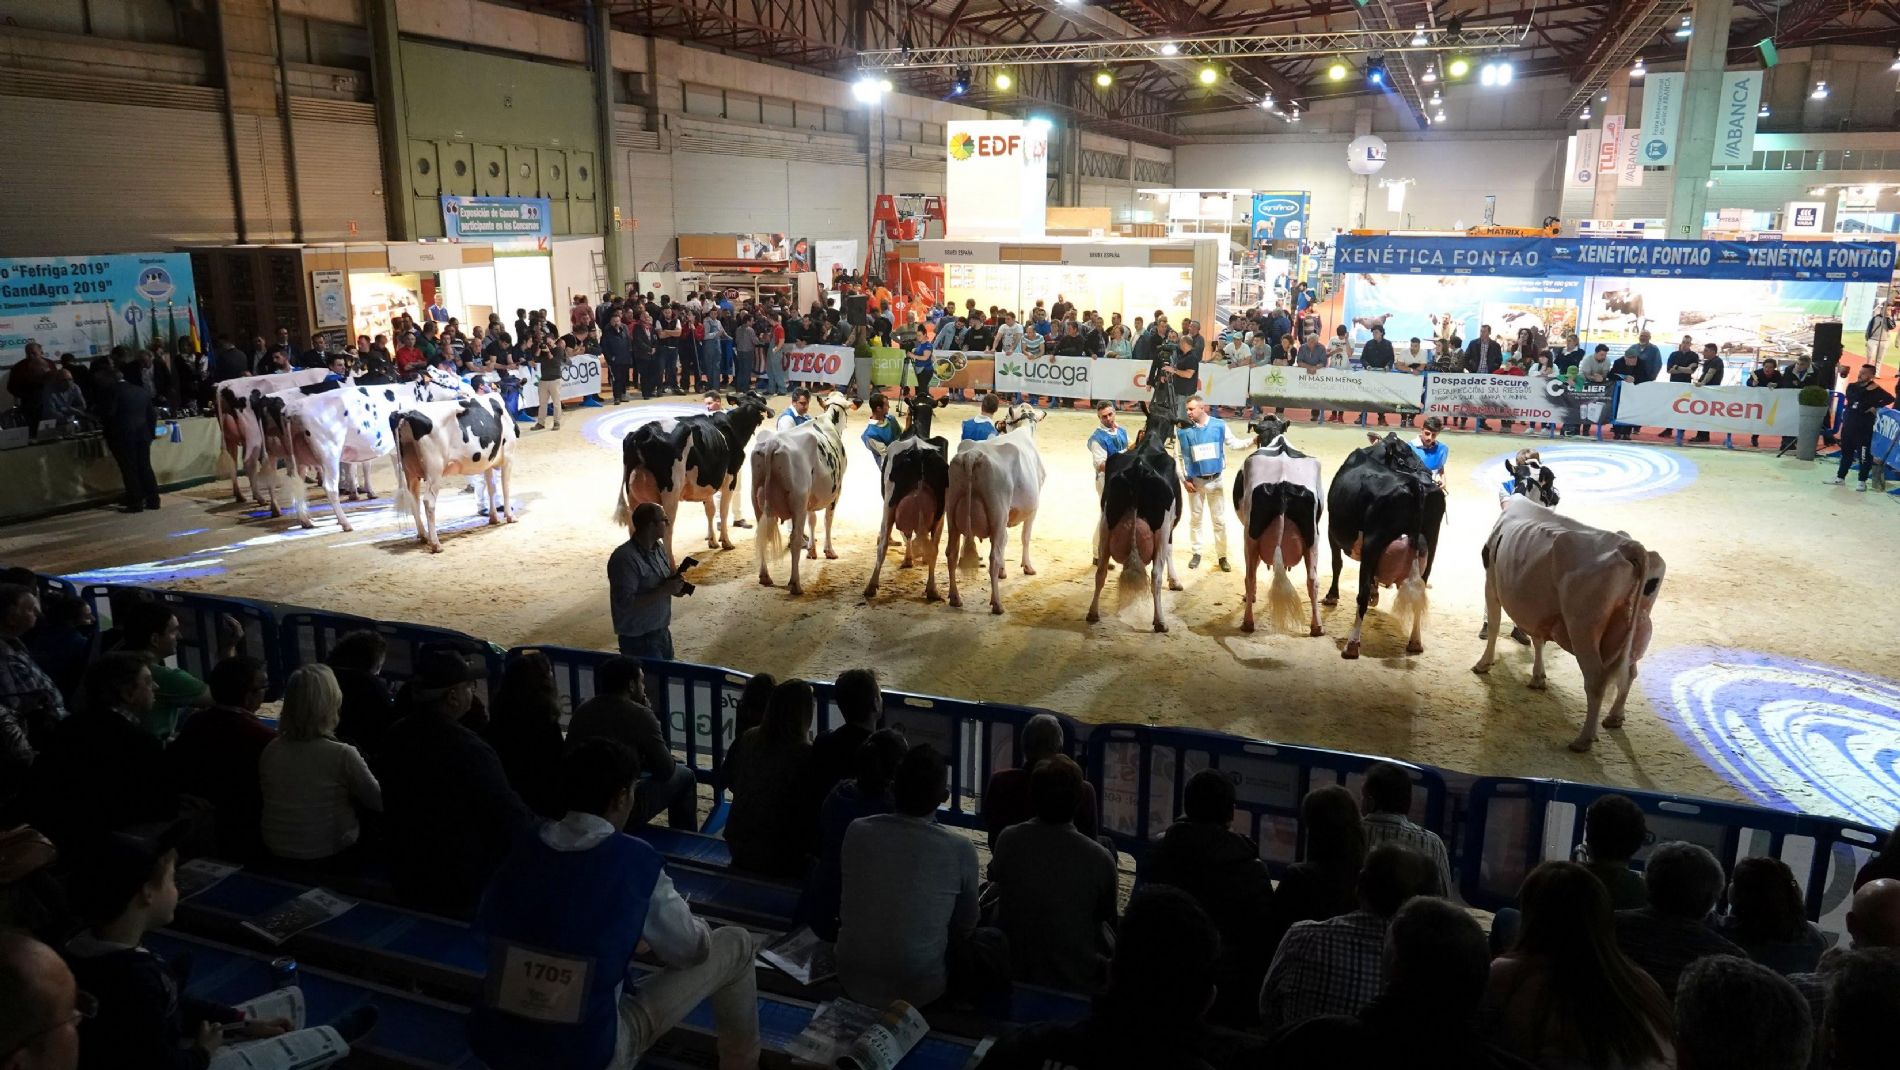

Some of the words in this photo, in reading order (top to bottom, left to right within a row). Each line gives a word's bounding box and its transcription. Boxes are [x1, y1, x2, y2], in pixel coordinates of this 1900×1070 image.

[978, 135, 1021, 156] EDF
[1340, 244, 1444, 265] XENÉTICA
[1453, 249, 1539, 266] FONTAO
[1577, 241, 1648, 265] XENÉTICA
[1652, 246, 1711, 266] FONTAO
[1746, 243, 1823, 267] XENÉTICA
[1827, 248, 1892, 268] FONTAO
[560, 361, 600, 384] coga
[1024, 361, 1088, 386] ucoga
[1433, 376, 1487, 386] Despadac
[1490, 377, 1529, 387] Secure
[1430, 404, 1449, 412] SIN
[523, 961, 573, 985] 1705
